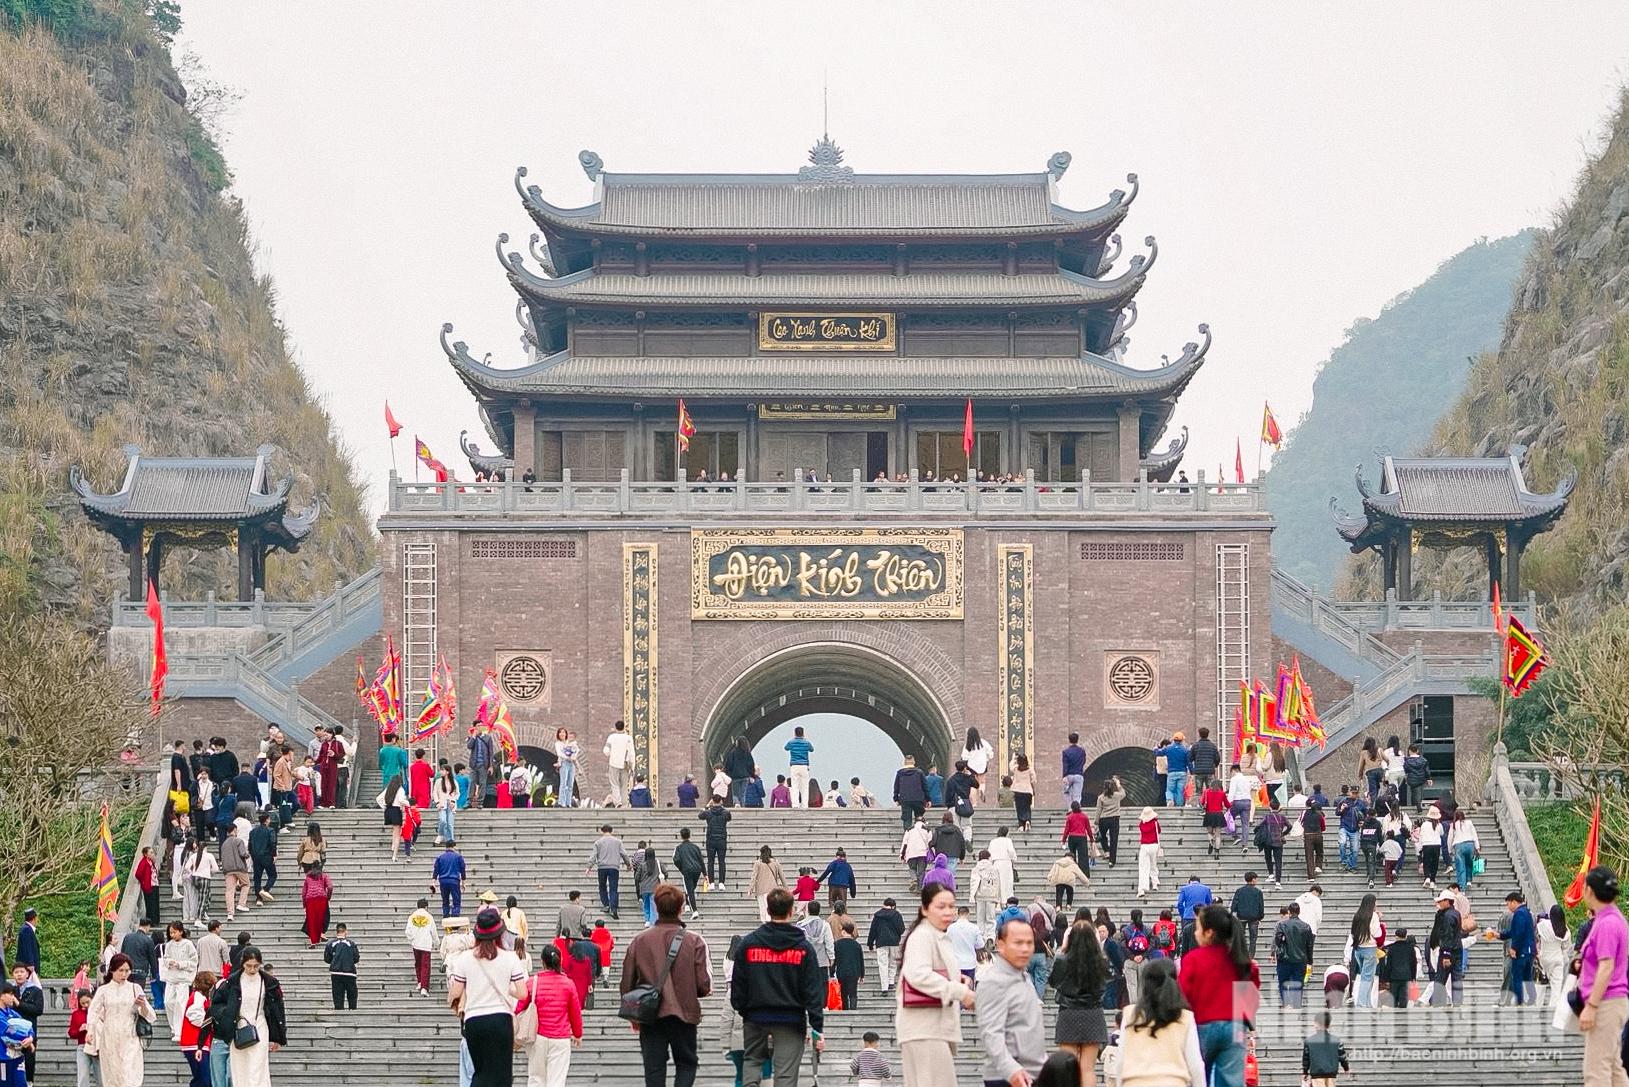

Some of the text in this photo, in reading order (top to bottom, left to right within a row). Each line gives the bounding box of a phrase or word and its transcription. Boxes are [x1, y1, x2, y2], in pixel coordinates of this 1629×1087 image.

[773, 319, 788, 339] Cao
[713, 548, 943, 600] Điện Kính Thiên
